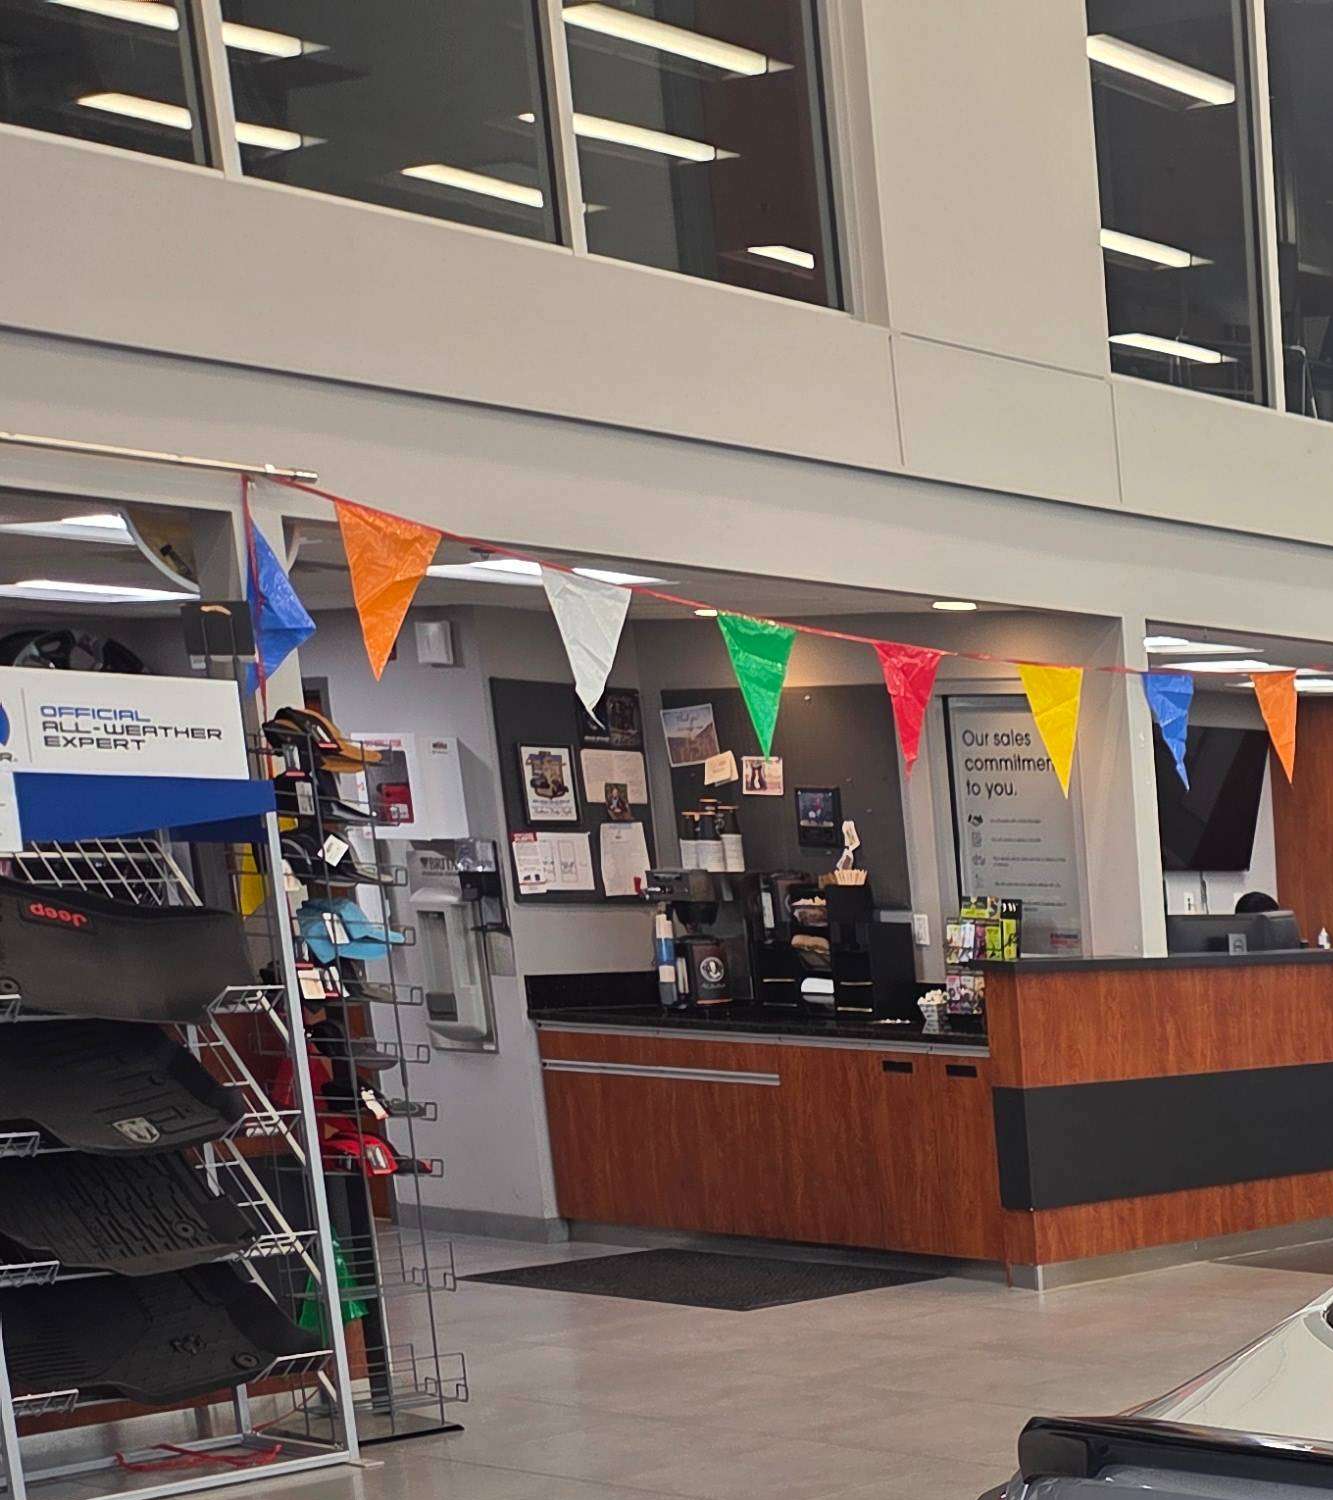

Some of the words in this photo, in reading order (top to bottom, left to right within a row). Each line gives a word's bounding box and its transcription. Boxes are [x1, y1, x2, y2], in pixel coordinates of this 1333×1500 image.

[40, 705, 150, 722] OFFICIAL
[42, 721, 223, 740] ALL-WEATHER
[962, 729, 989, 747] Our
[993, 728, 1031, 747] sales
[44, 736, 146, 751] EXPERT
[964, 754, 1056, 772] commitmen
[966, 779, 981, 796] to
[985, 781, 1017, 800] you.
[30, 903, 87, 927] Jeep
